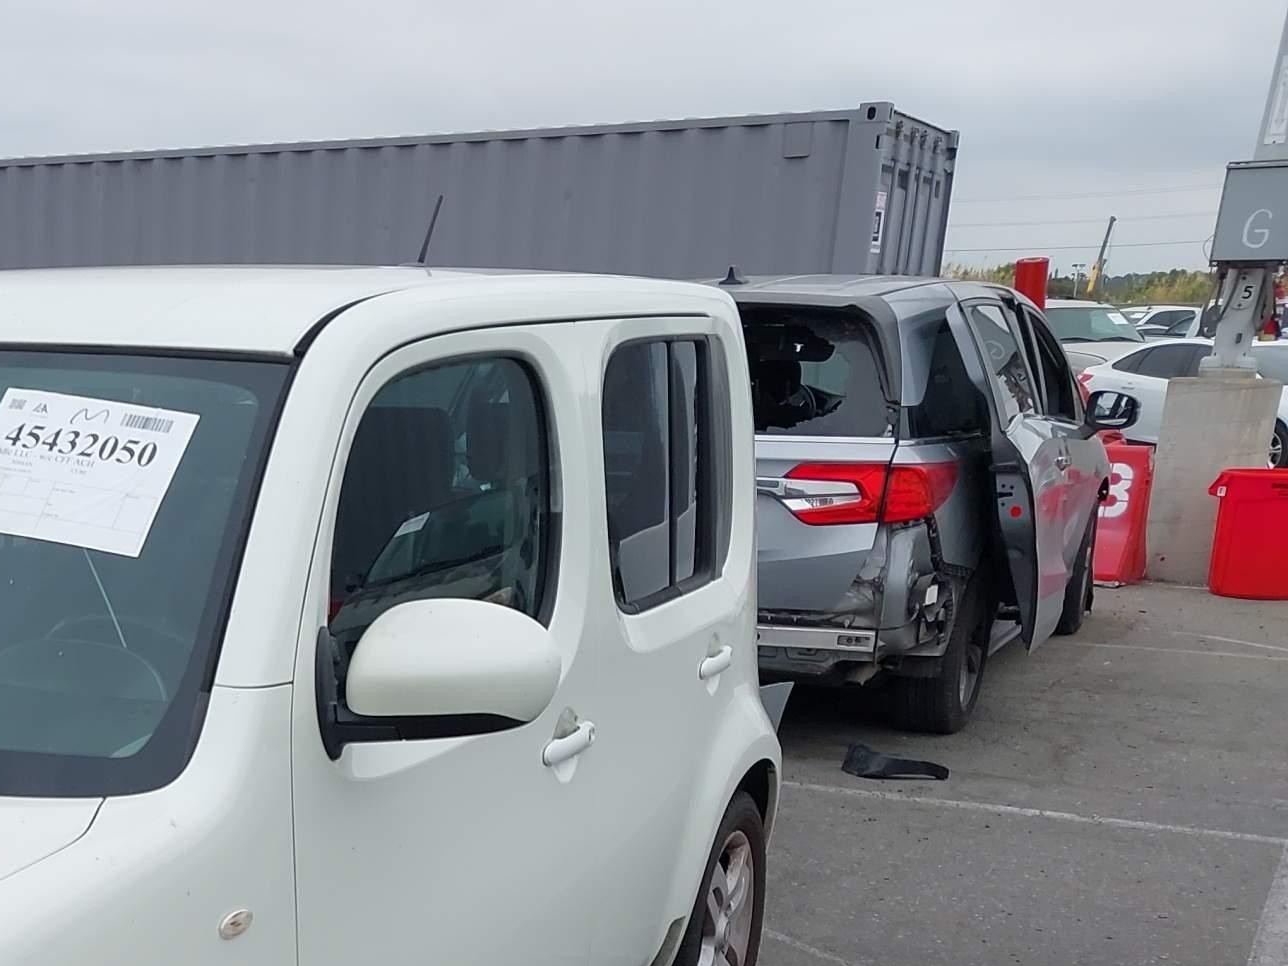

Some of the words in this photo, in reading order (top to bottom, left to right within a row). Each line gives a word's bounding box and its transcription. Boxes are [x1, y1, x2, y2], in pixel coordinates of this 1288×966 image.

[1241, 208, 1273, 249] G
[1241, 285, 1254, 300] 5
[4, 421, 158, 467] 45432050
